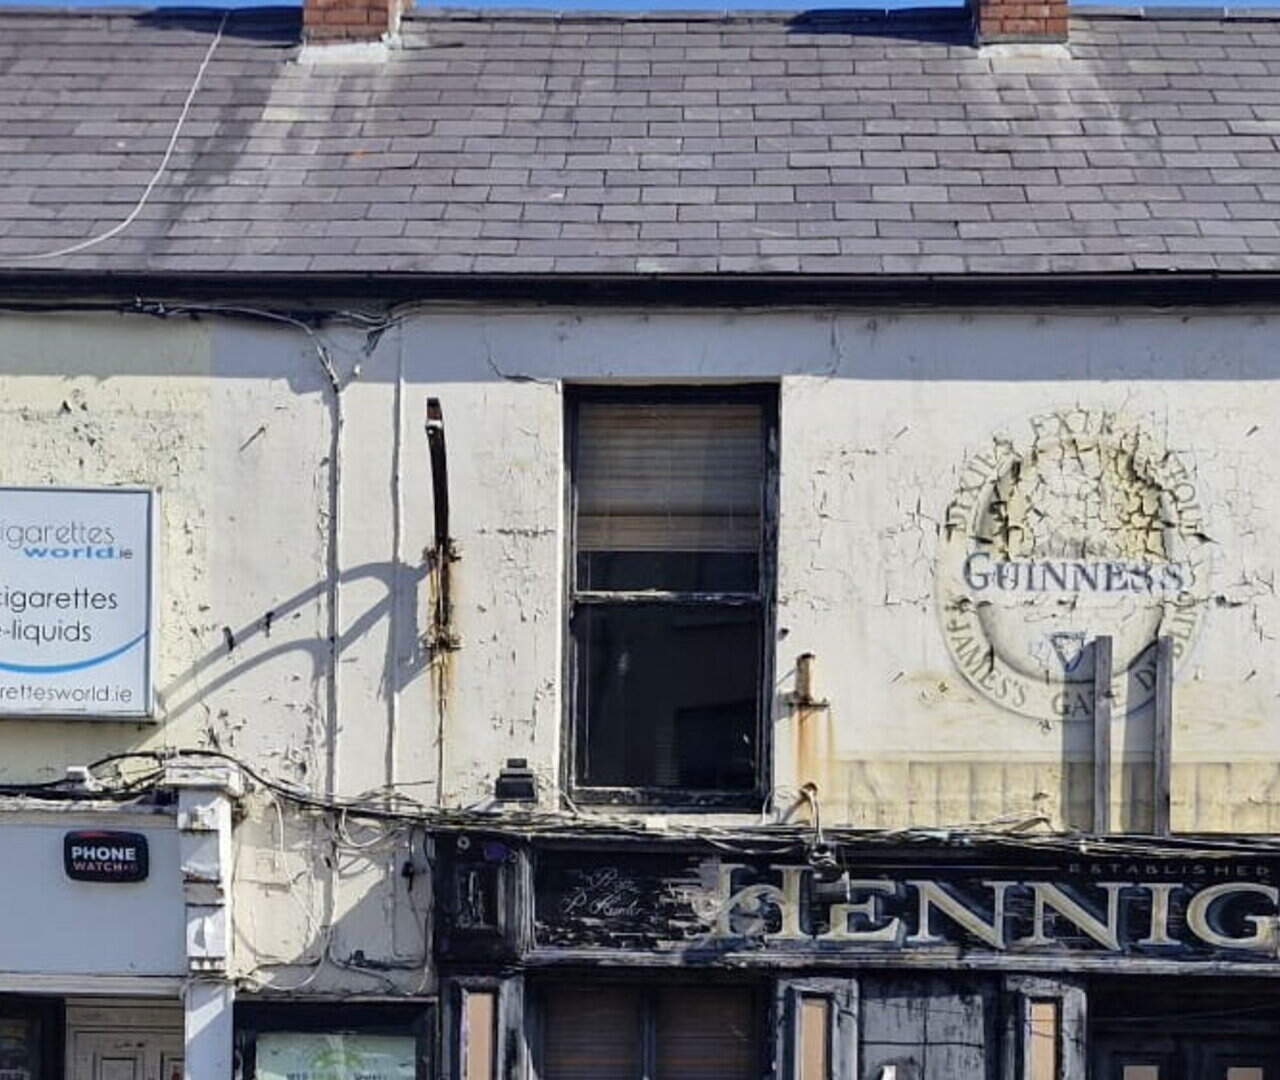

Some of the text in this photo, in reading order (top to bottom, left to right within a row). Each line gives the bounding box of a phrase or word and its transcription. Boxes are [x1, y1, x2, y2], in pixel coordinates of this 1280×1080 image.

[963, 551, 1185, 594] GUINNESS
[71, 845, 137, 861] PHONE
[1068, 863, 1272, 877] ESTABLISHED
